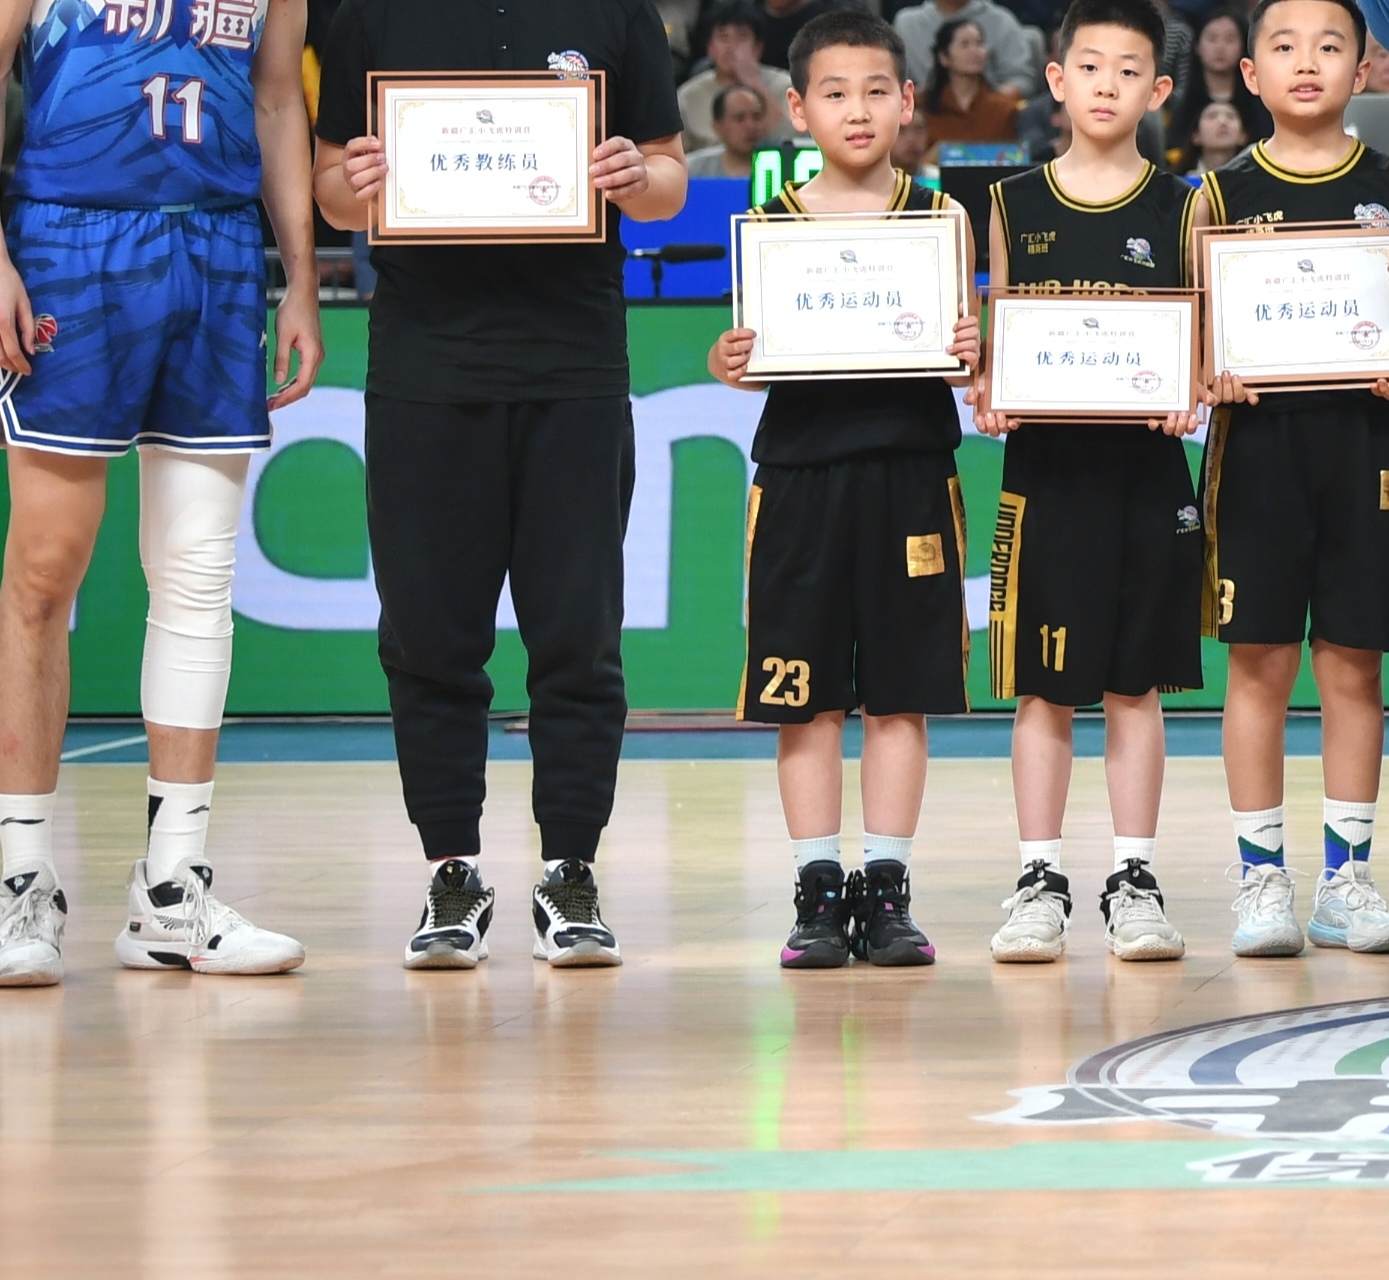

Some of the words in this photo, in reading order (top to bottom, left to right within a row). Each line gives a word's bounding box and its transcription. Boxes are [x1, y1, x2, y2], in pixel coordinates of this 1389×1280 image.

[142, 72, 205, 144] 11
[430, 152, 539, 173] 优秀教练员
[796, 290, 904, 311] 优秀运动员
[1255, 300, 1360, 323] 优秀运动员
[1036, 351, 1142, 368] 优秀运动员
[1039, 624, 1067, 673] 11
[759, 656, 811, 708] 23
